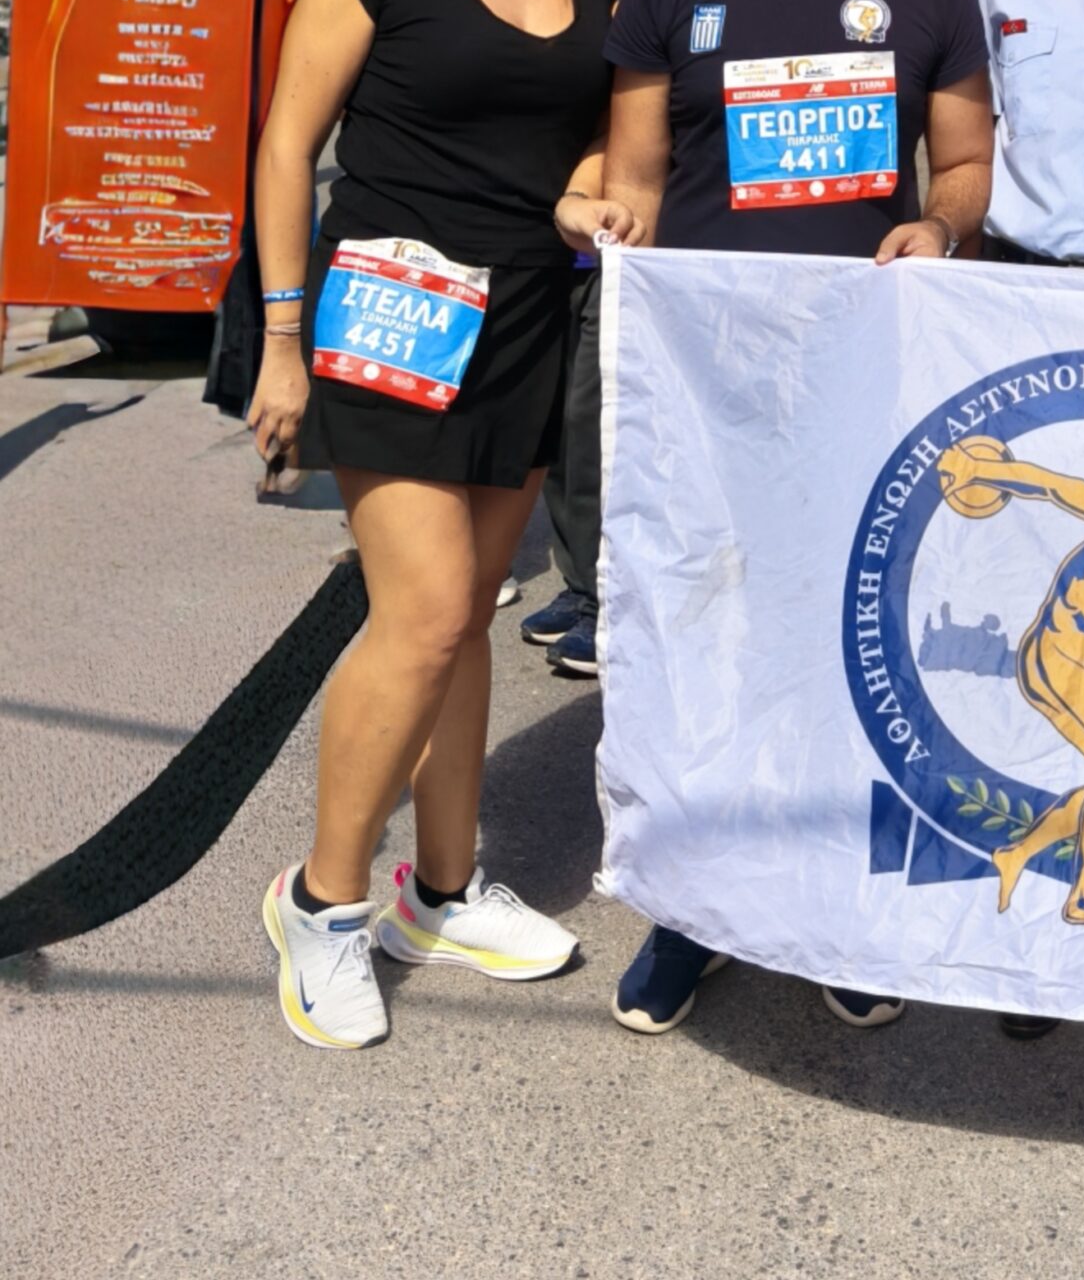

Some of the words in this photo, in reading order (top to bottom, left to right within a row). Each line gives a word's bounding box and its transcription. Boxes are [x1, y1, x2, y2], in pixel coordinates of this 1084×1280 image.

[740, 103, 884, 140] ΓΕΩΡΓΙΟΣ
[779, 145, 846, 172] 4411
[341, 279, 450, 334] ΣΤΕΛΛΑ
[345, 322, 417, 362] 4451
[863, 436, 944, 559] ΕΝΩΣΗ
[856, 567, 931, 766] ΑΘΛΗΤΙΚΗ
